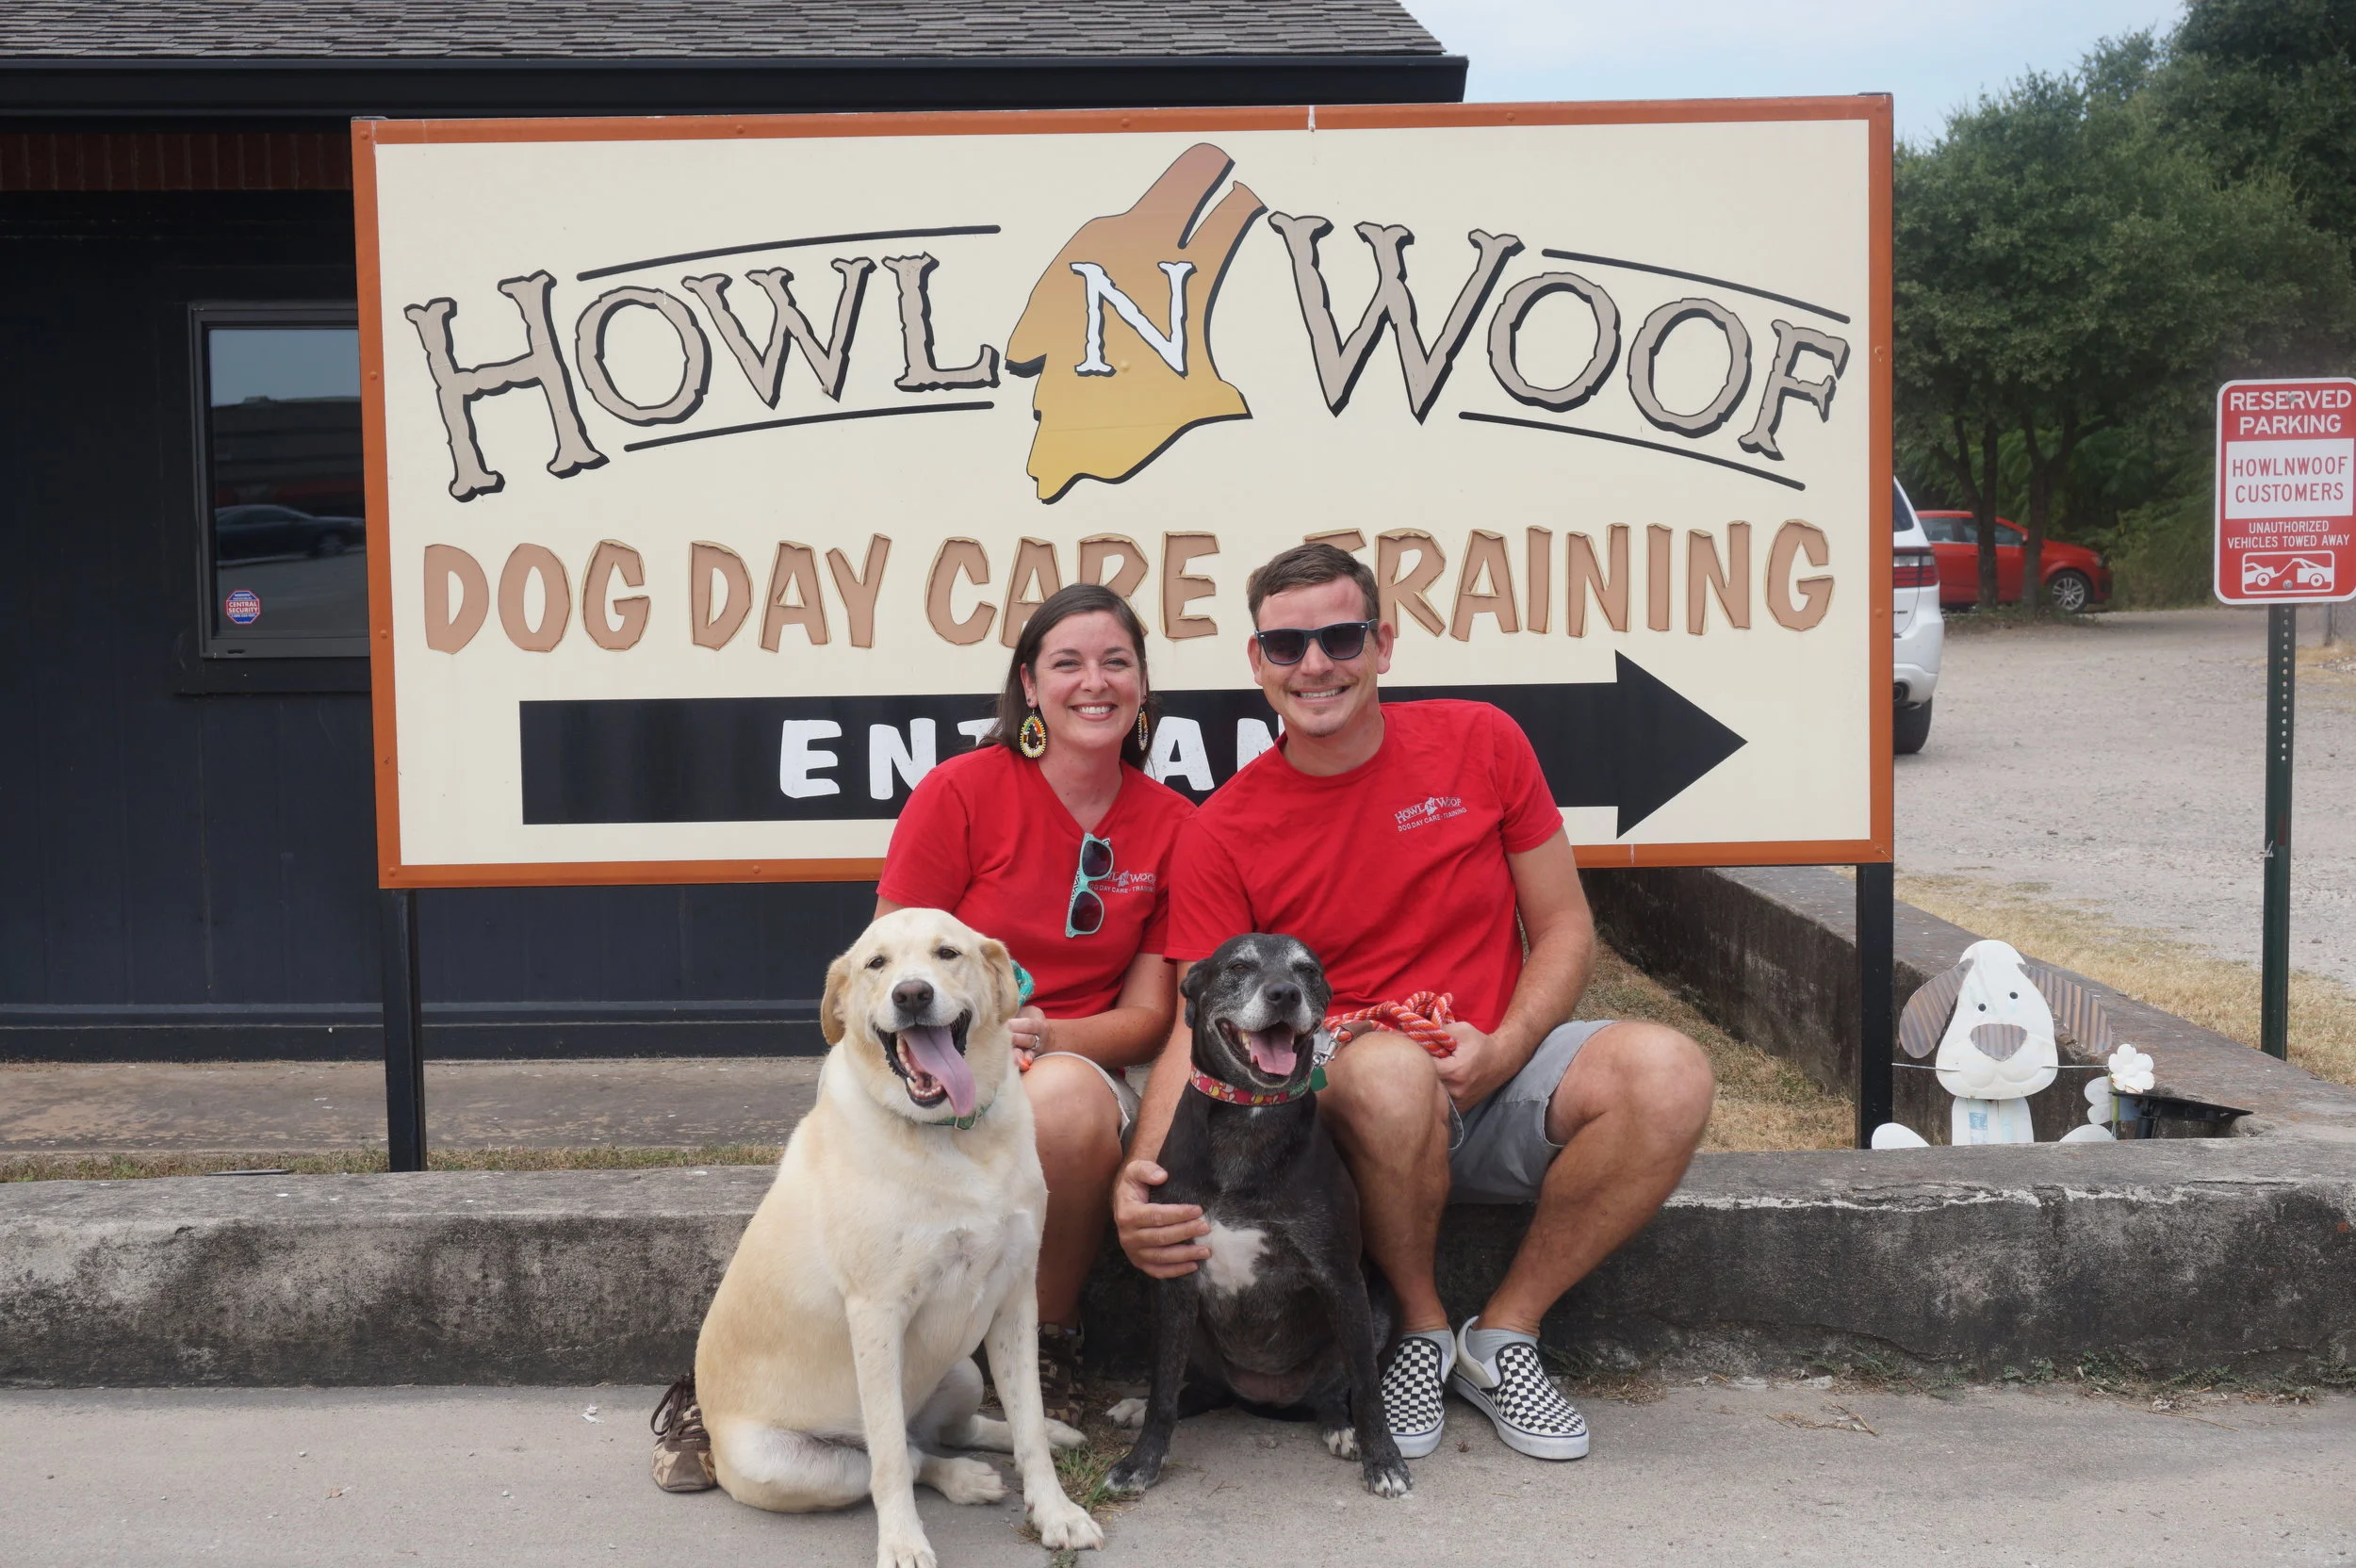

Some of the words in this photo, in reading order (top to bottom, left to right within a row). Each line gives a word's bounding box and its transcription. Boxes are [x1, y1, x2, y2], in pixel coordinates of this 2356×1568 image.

[403, 251, 1001, 503] HOWL
[1069, 260, 1198, 379] N
[1268, 210, 1851, 462] WOOF
[2230, 389, 2352, 412] RESERVED
[2239, 414, 2342, 435] PARKING
[2232, 456, 2348, 478] HOWLNWOOF
[2234, 482, 2344, 503] CUSTOMERS
[2249, 520, 2330, 534] UNAUTHORIZED
[2227, 535, 2279, 549] VEHICLES
[2282, 534, 2317, 547] TOWED
[2321, 533, 2350, 547] AWAY
[422, 538, 652, 655] DOG
[688, 533, 892, 654] DAY
[924, 530, 1220, 648] CARE
[1395, 805, 1426, 824] HOWL
[1398, 823, 1411, 832] DOG
[1411, 819, 1423, 828] DAY
[1424, 814, 1440, 824] CARE
[1129, 873, 1156, 885] WOO
